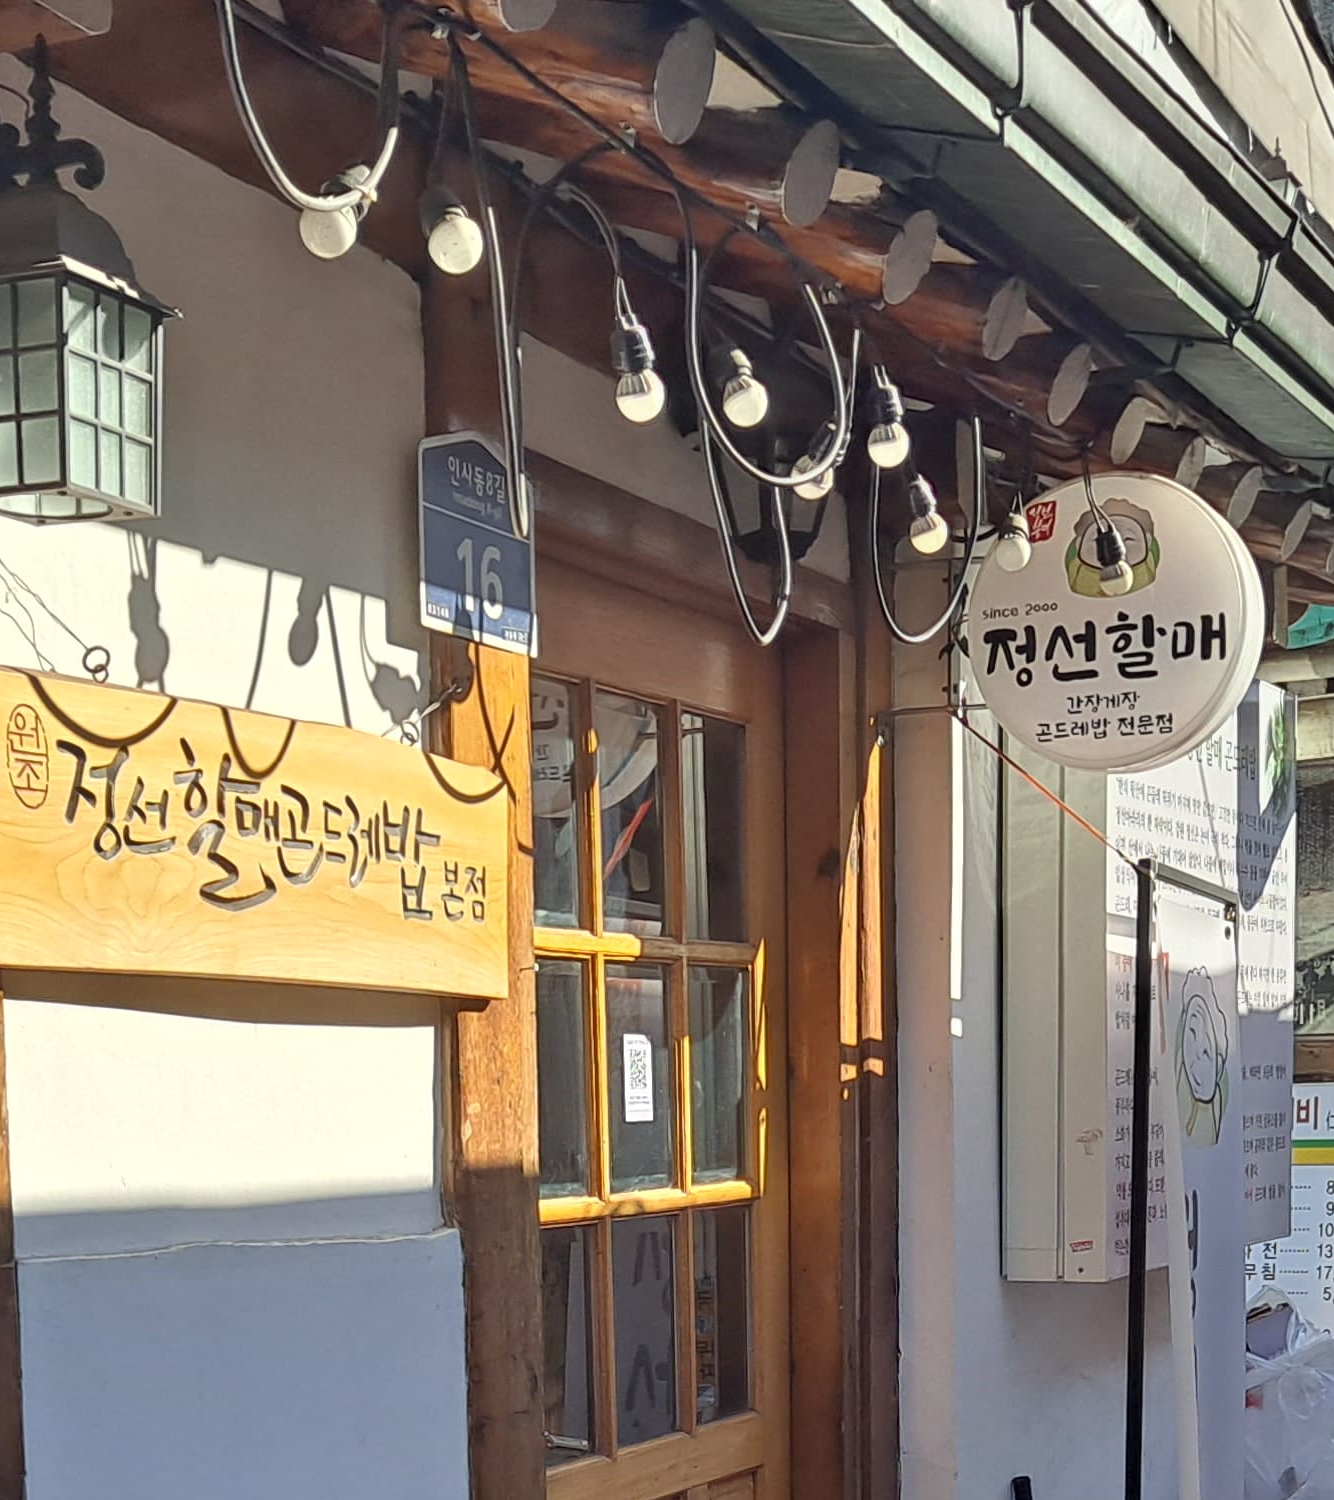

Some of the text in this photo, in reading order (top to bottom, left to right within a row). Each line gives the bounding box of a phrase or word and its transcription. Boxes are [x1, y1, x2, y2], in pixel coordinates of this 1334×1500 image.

[447, 455, 507, 505] 인사동8길
[456, 537, 504, 620] 16
[982, 602, 1058, 621] since 2000
[983, 612, 1227, 687] 정선할매
[1035, 713, 1174, 742] 곤드레밥 전문점
[1066, 691, 1141, 715] 간장게장
[8, 706, 49, 795] 원조
[442, 859, 487, 923] 본점
